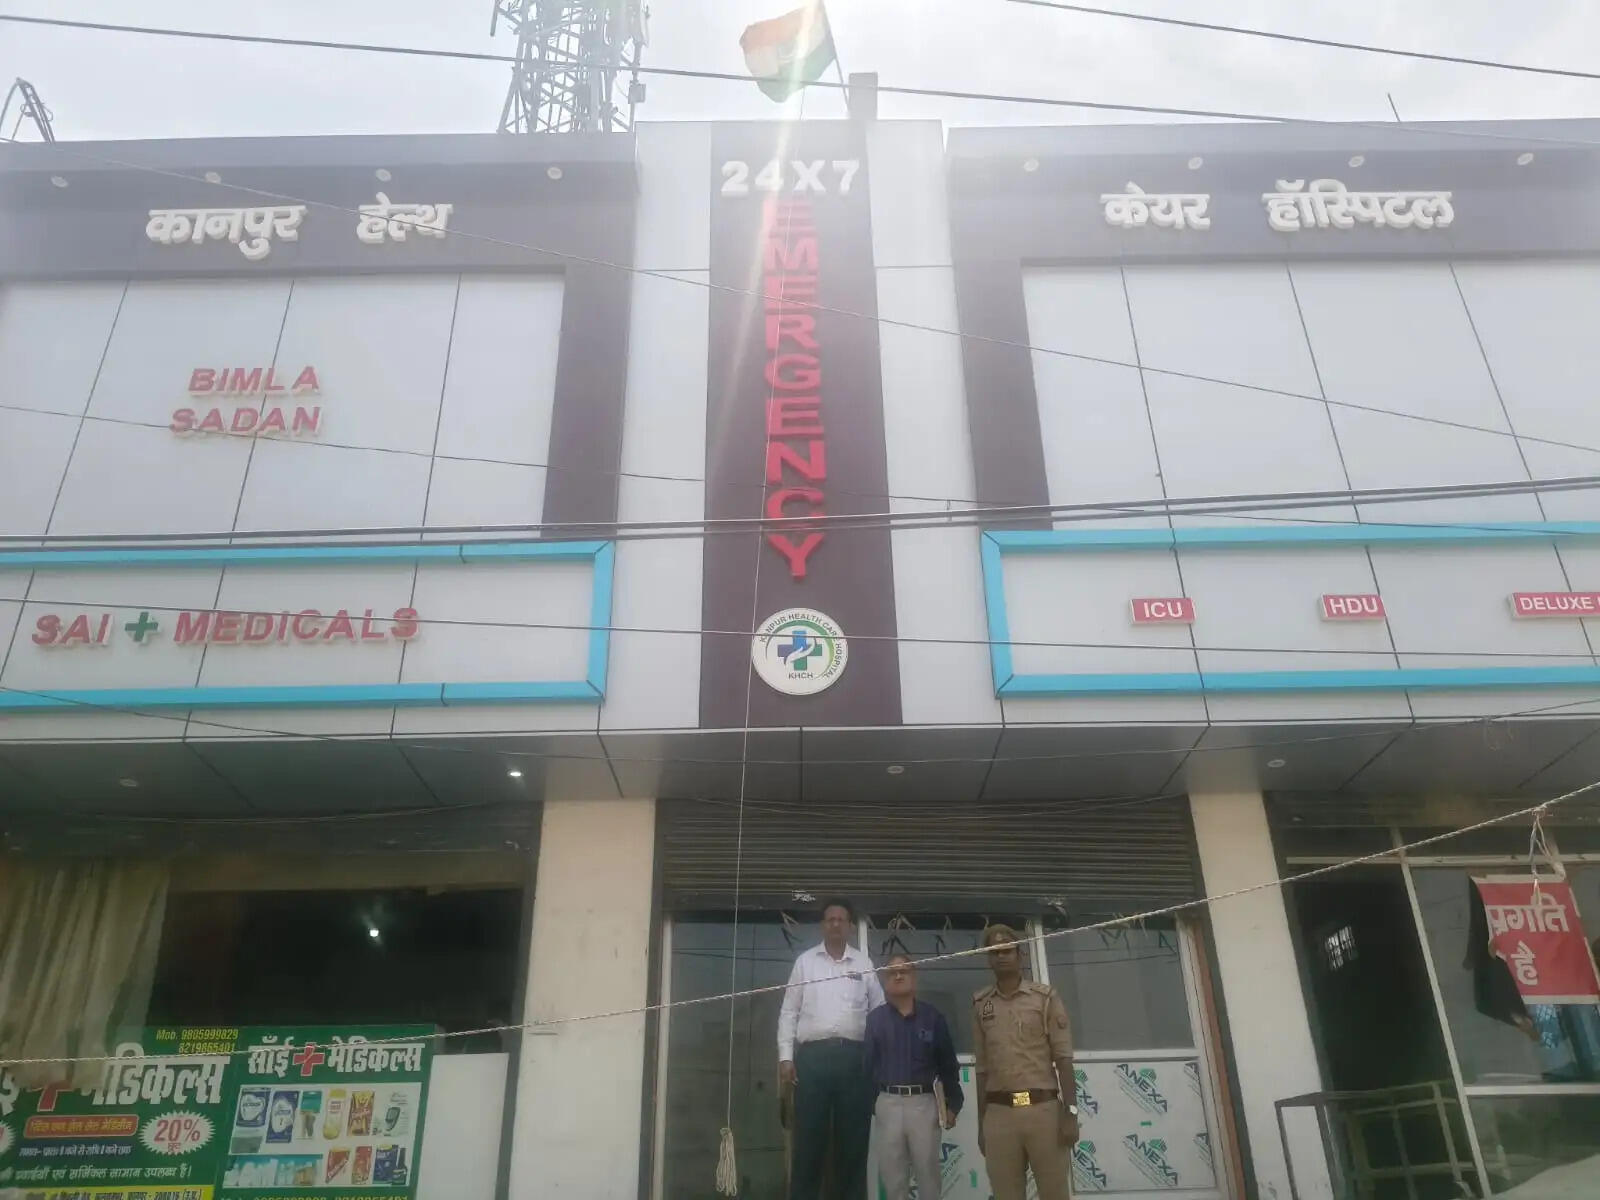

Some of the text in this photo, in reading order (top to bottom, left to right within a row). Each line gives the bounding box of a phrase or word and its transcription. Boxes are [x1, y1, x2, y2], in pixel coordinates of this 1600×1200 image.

[721, 159, 860, 195] 24X7
[1101, 178, 1455, 231] केयर हॉस्पिटल
[146, 192, 453, 260] कानपुर हेल्थ
[188, 366, 320, 396] BIMLA
[763, 196, 828, 581] EMERGENCY
[169, 406, 321, 437] SADAN
[1143, 602, 1183, 618] ICU
[1330, 597, 1379, 615] HDU
[1519, 597, 1595, 611] DELUXE
[31, 606, 420, 647] SAI MEDICALS
[788, 613, 820, 625] HEALTH
[823, 643, 842, 678] HOSPITAL
[788, 671, 814, 680] KHCH
[1510, 940, 1538, 985] है
[153, 1119, 200, 1142] 20%
